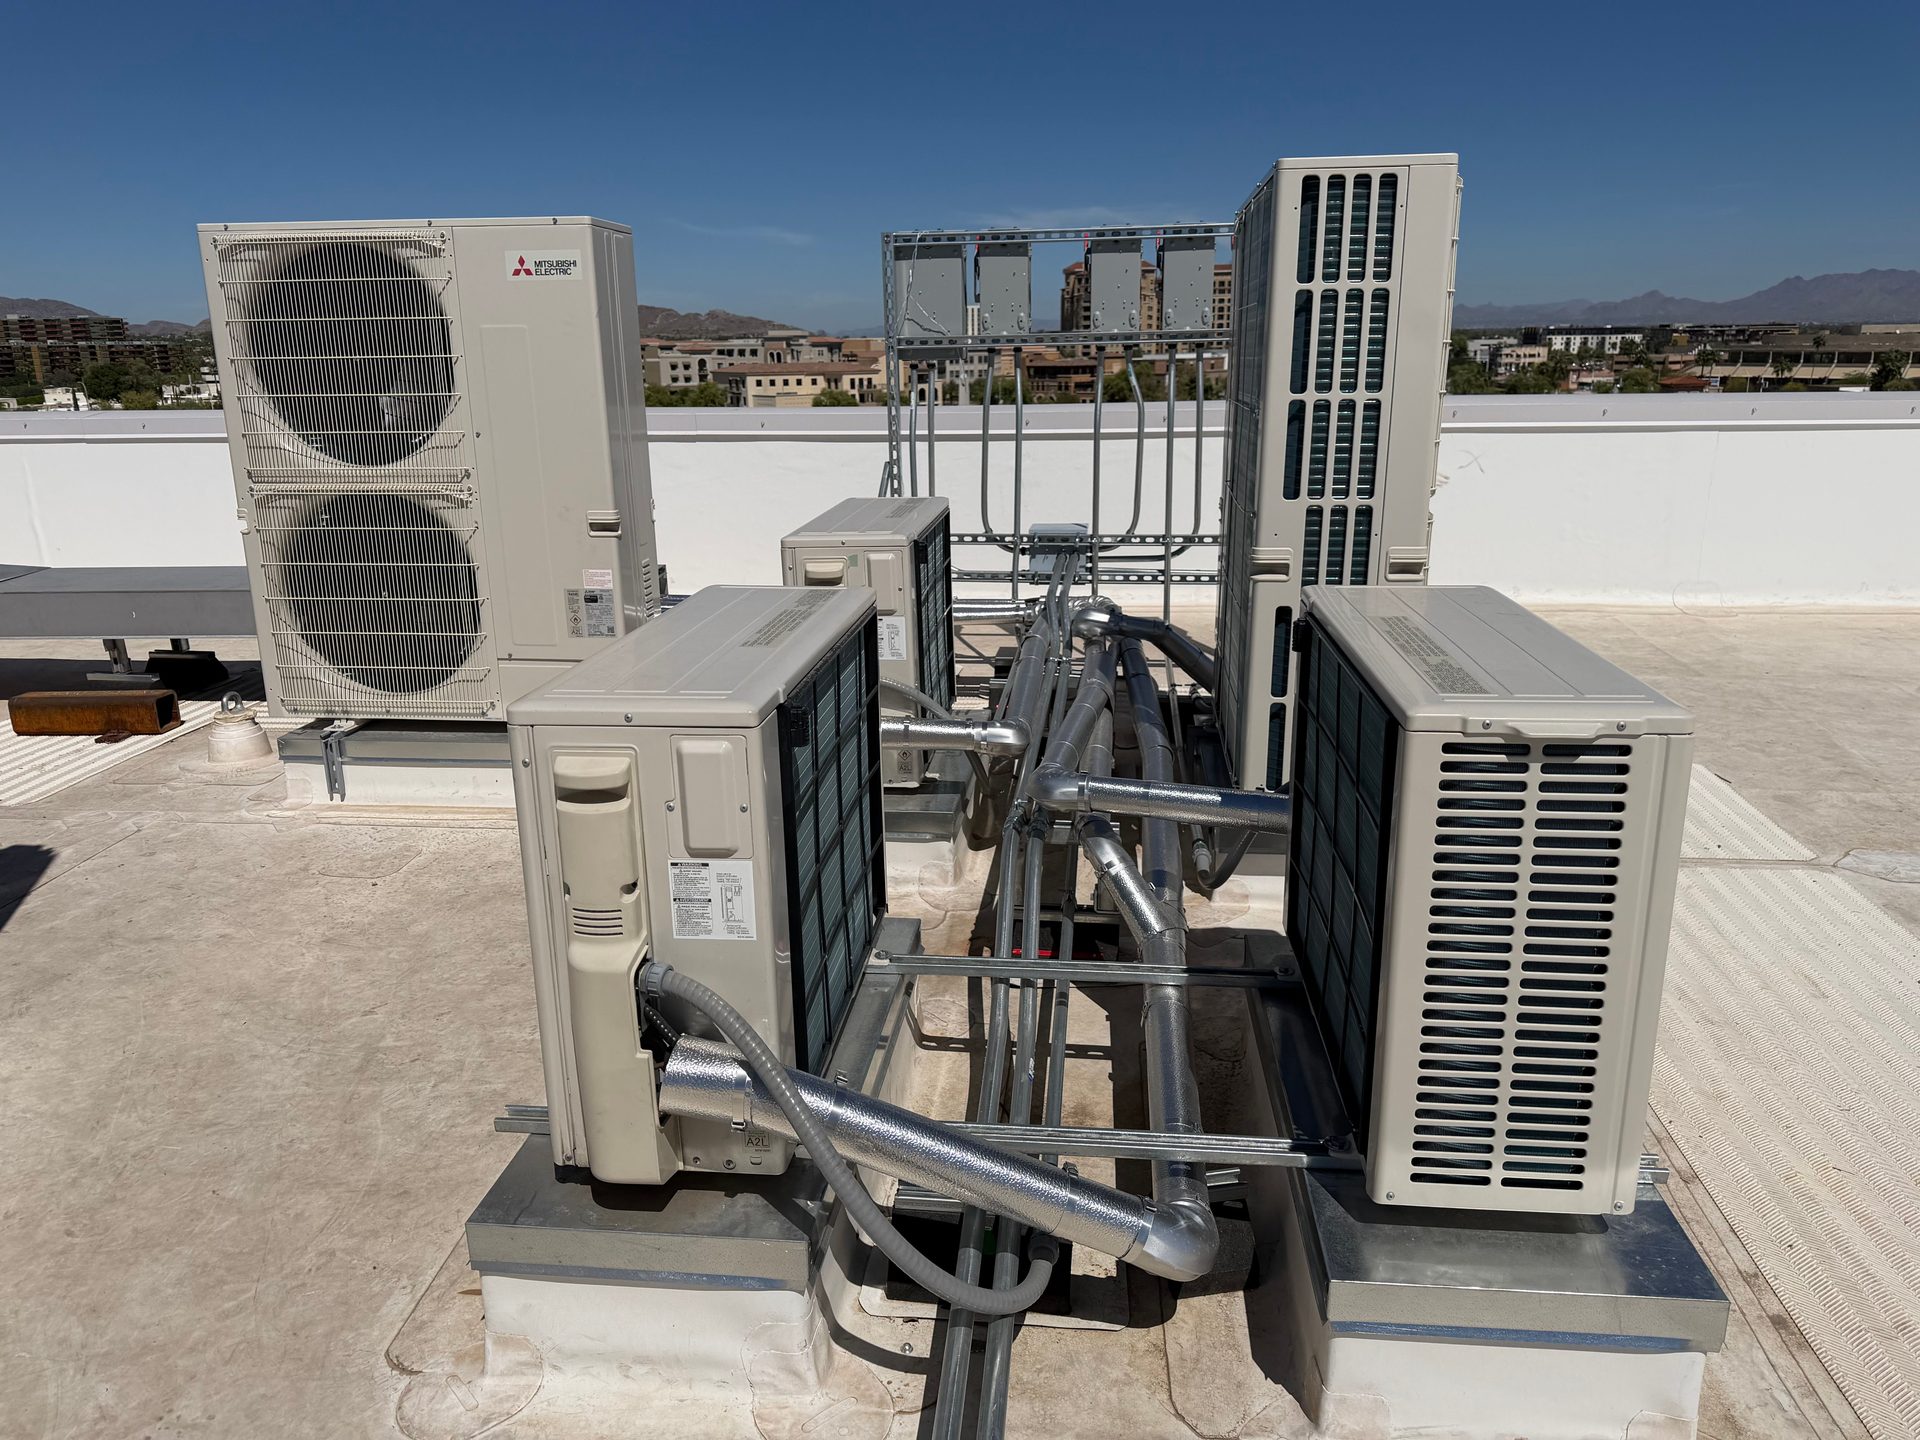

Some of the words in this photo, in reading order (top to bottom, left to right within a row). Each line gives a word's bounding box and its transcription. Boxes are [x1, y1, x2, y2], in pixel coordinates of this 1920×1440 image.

[534, 260, 577, 268] MITSUBISHI
[535, 268, 572, 276] ELECTRIC
[747, 1137, 768, 1147] A2L
